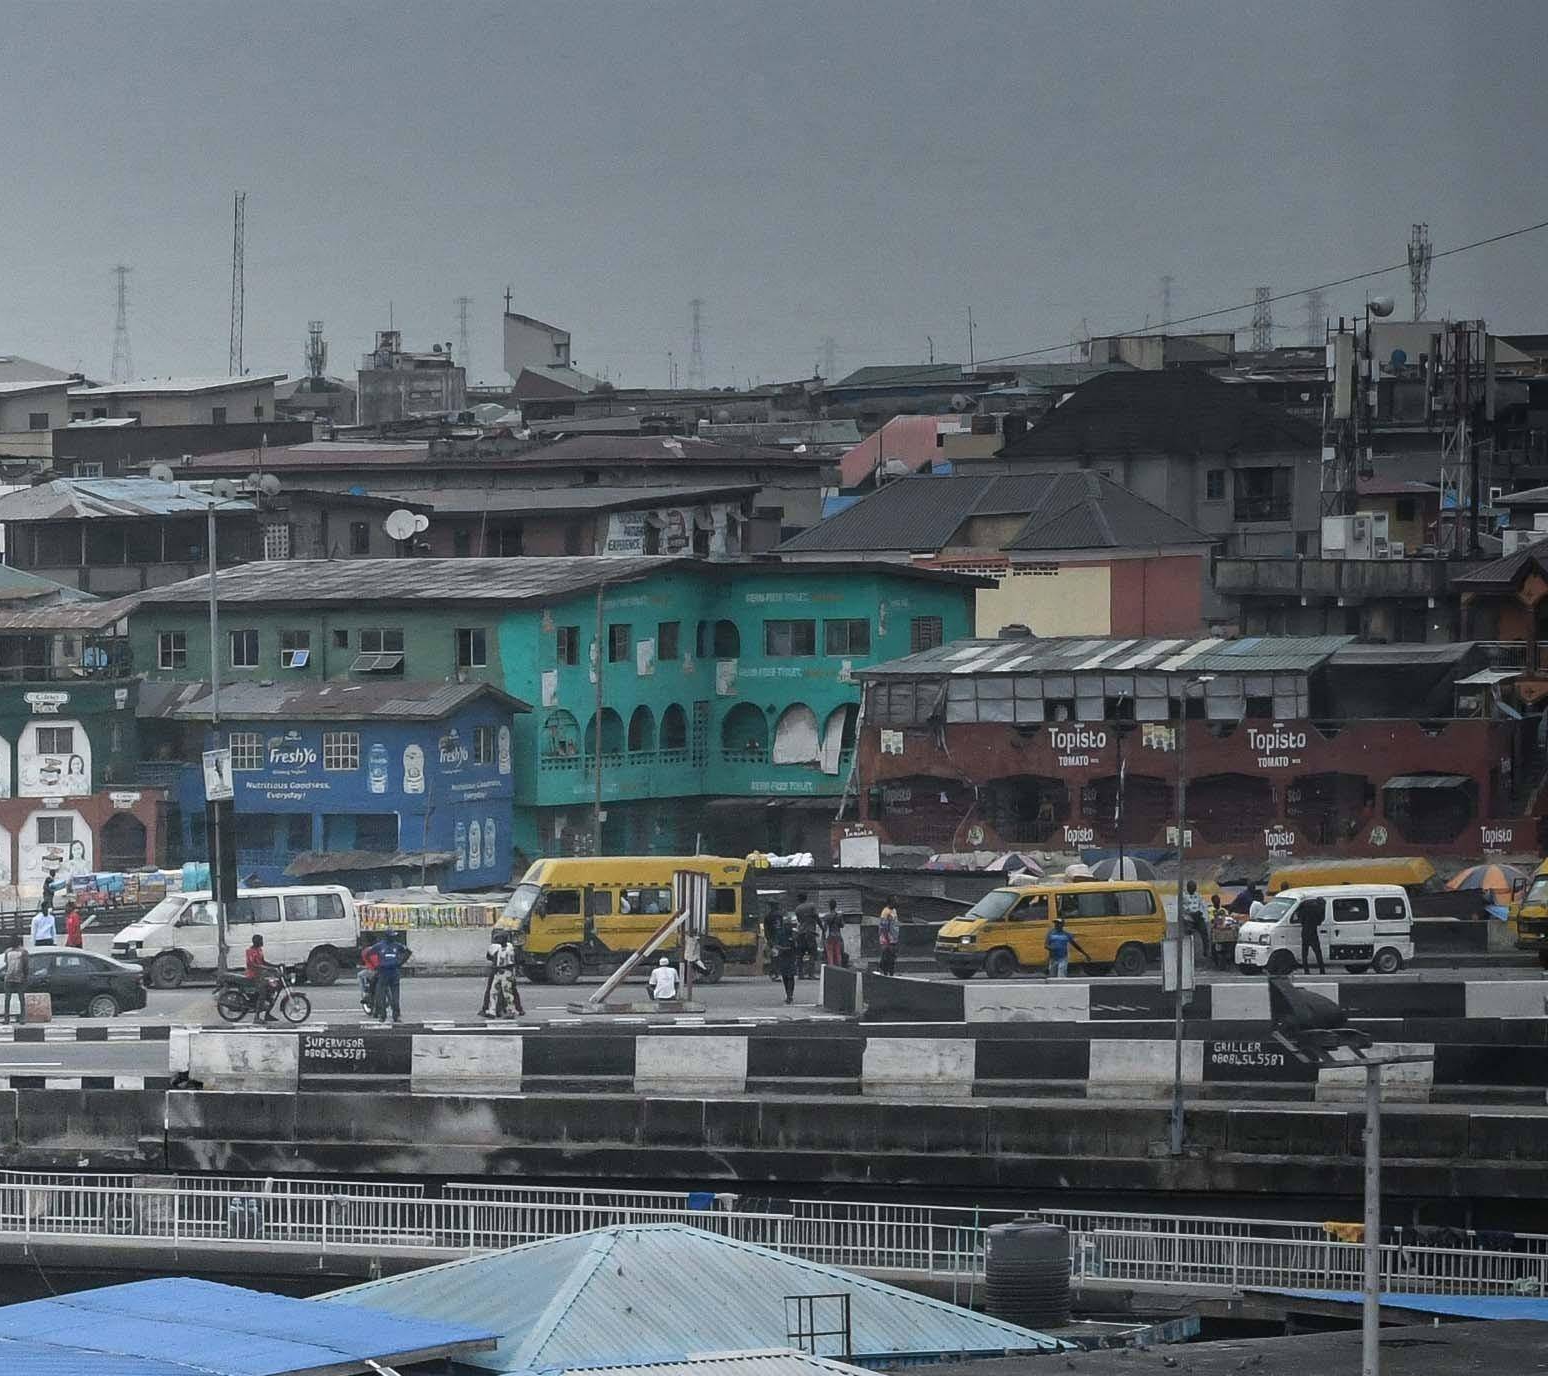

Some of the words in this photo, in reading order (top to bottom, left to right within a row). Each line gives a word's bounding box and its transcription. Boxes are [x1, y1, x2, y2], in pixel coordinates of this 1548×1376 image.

[1048, 727, 1107, 754] Topisto
[1247, 727, 1306, 754] Topisto
[269, 748, 317, 768] FreshYo
[439, 747, 469, 768] FreshYo
[1058, 755, 1089, 767] TOMATO
[1257, 756, 1289, 768] TOMATO
[246, 781, 288, 790] Nutritious
[1063, 825, 1094, 846] Topisto
[1264, 829, 1295, 850] Topisto
[1480, 825, 1513, 847] Topisto
[304, 1035, 365, 1048] SUPERVISOR
[1213, 1042, 1261, 1053] GRILLER
